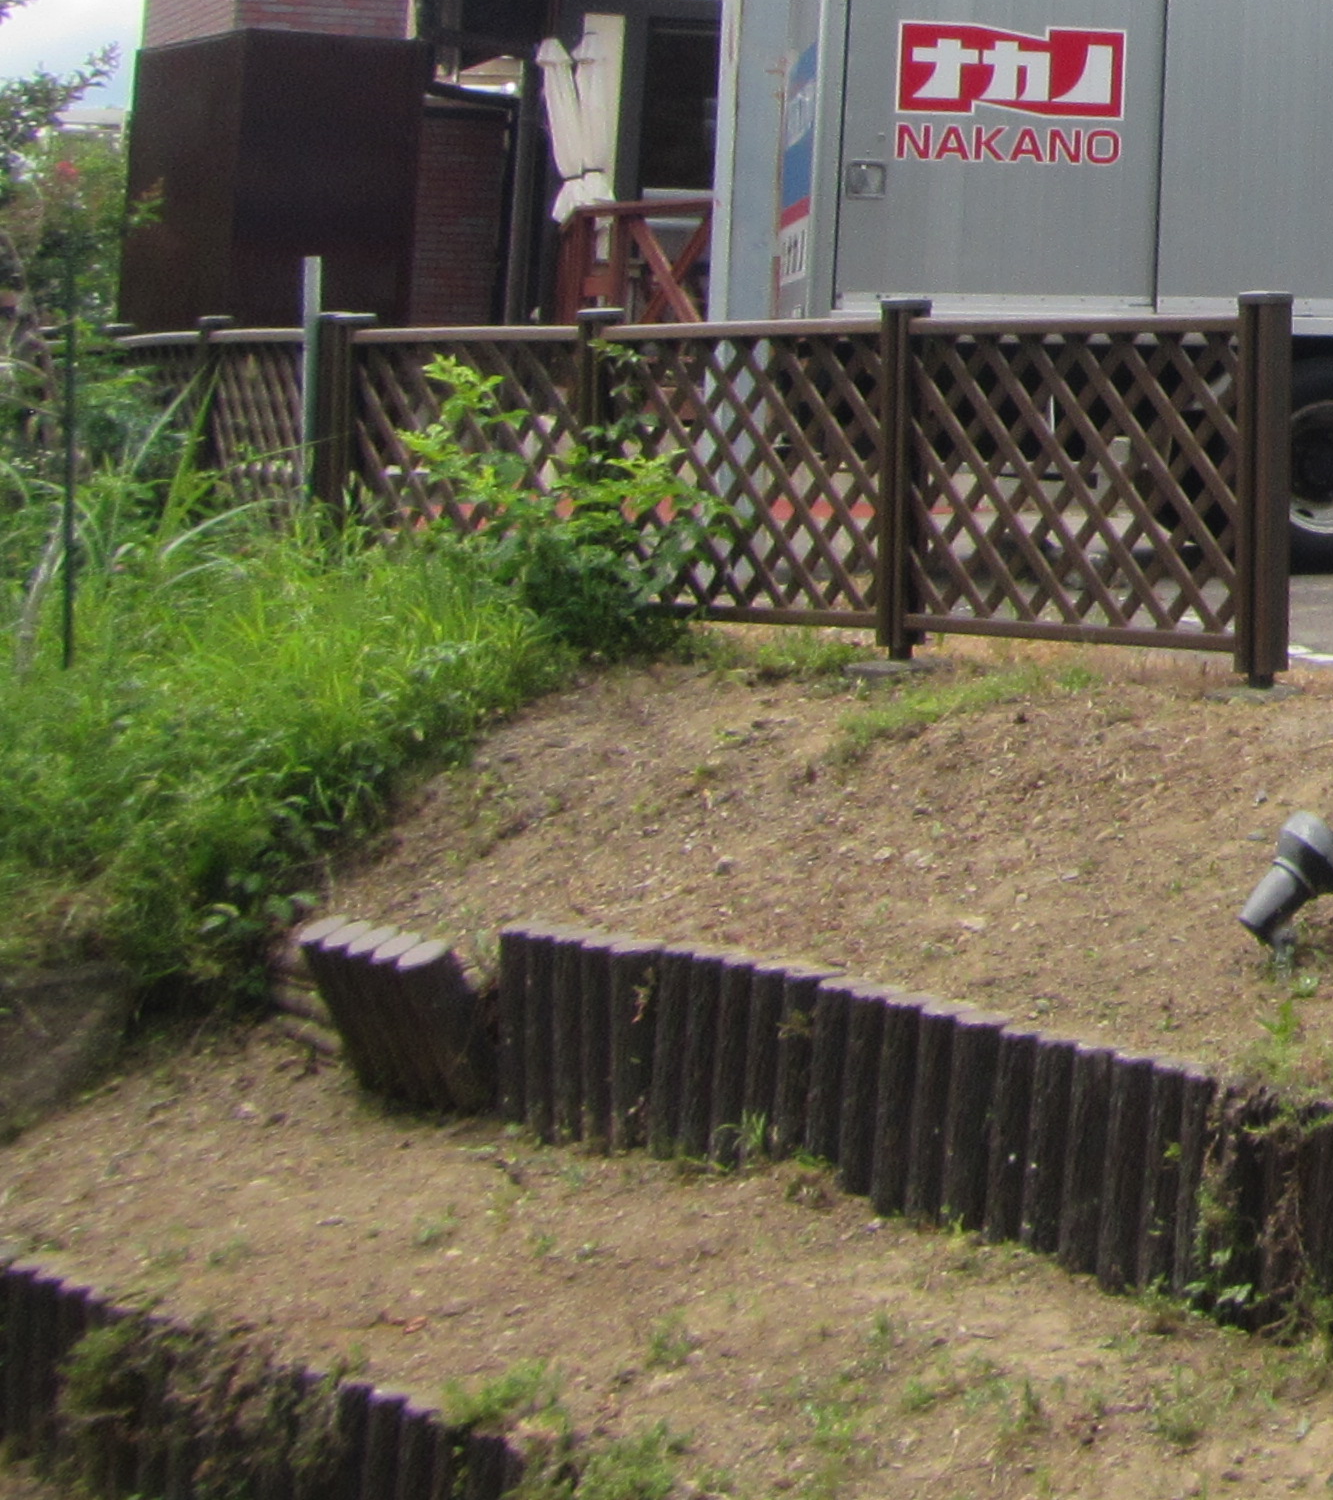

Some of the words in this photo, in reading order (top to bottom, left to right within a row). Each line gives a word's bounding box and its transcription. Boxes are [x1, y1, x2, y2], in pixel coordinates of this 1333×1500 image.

[911, 38, 1113, 104] ナカノ
[896, 123, 1121, 165] NAKANO
